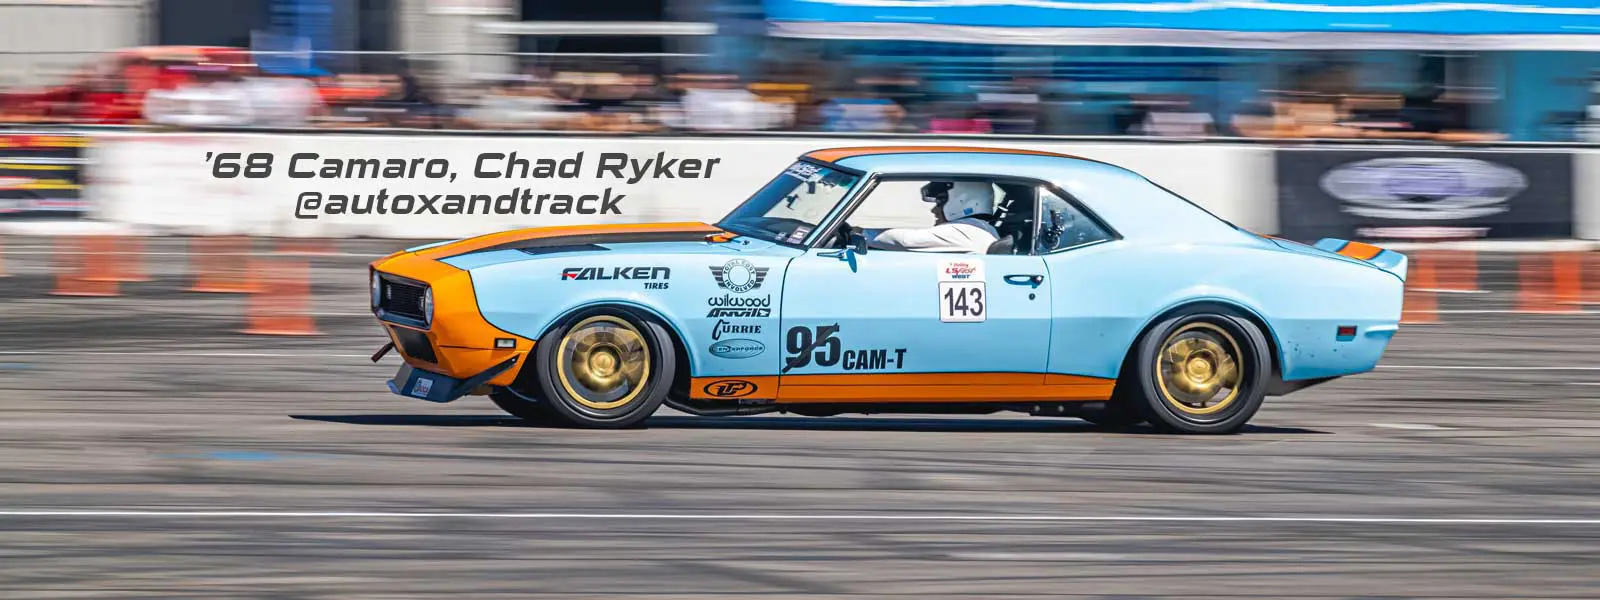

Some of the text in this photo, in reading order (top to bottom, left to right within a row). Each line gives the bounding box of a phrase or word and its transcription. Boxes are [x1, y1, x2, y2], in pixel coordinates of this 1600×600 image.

[561, 266, 671, 281] FALKEN
[644, 282, 669, 290] TIRES
[707, 293, 771, 308] wilwood
[944, 287, 984, 317] 143
[784, 324, 907, 370] 95 CAM-T
